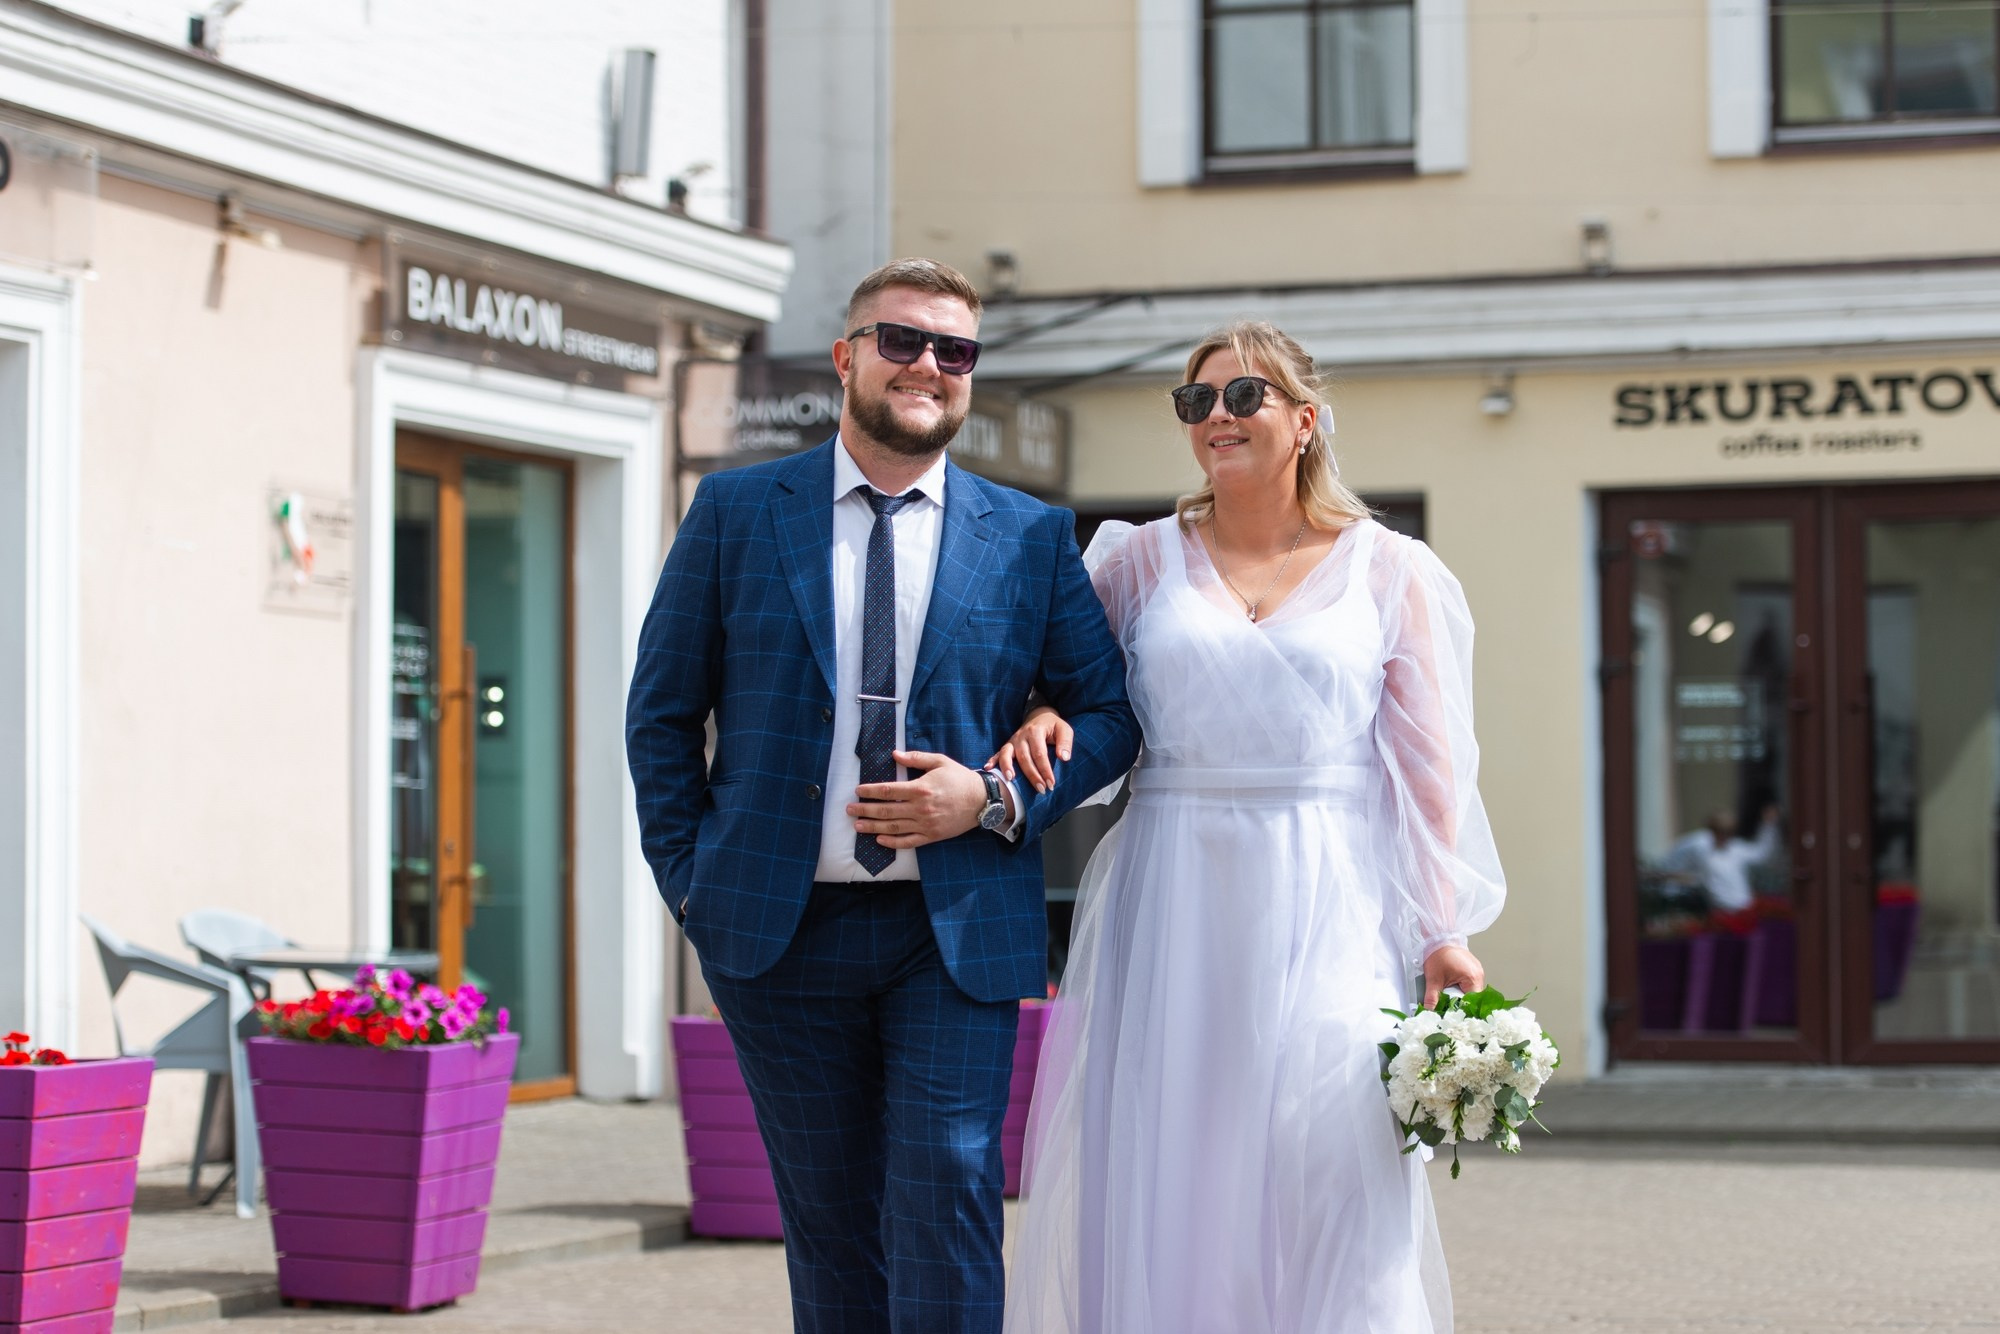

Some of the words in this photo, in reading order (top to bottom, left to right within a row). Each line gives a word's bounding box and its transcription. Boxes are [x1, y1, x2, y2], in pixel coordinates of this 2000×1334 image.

[407, 266, 563, 353] BALAXON
[563, 327, 658, 373] STREETWEAR
[1721, 429, 1802, 457] coffee
[1812, 428, 1922, 453] roasters
